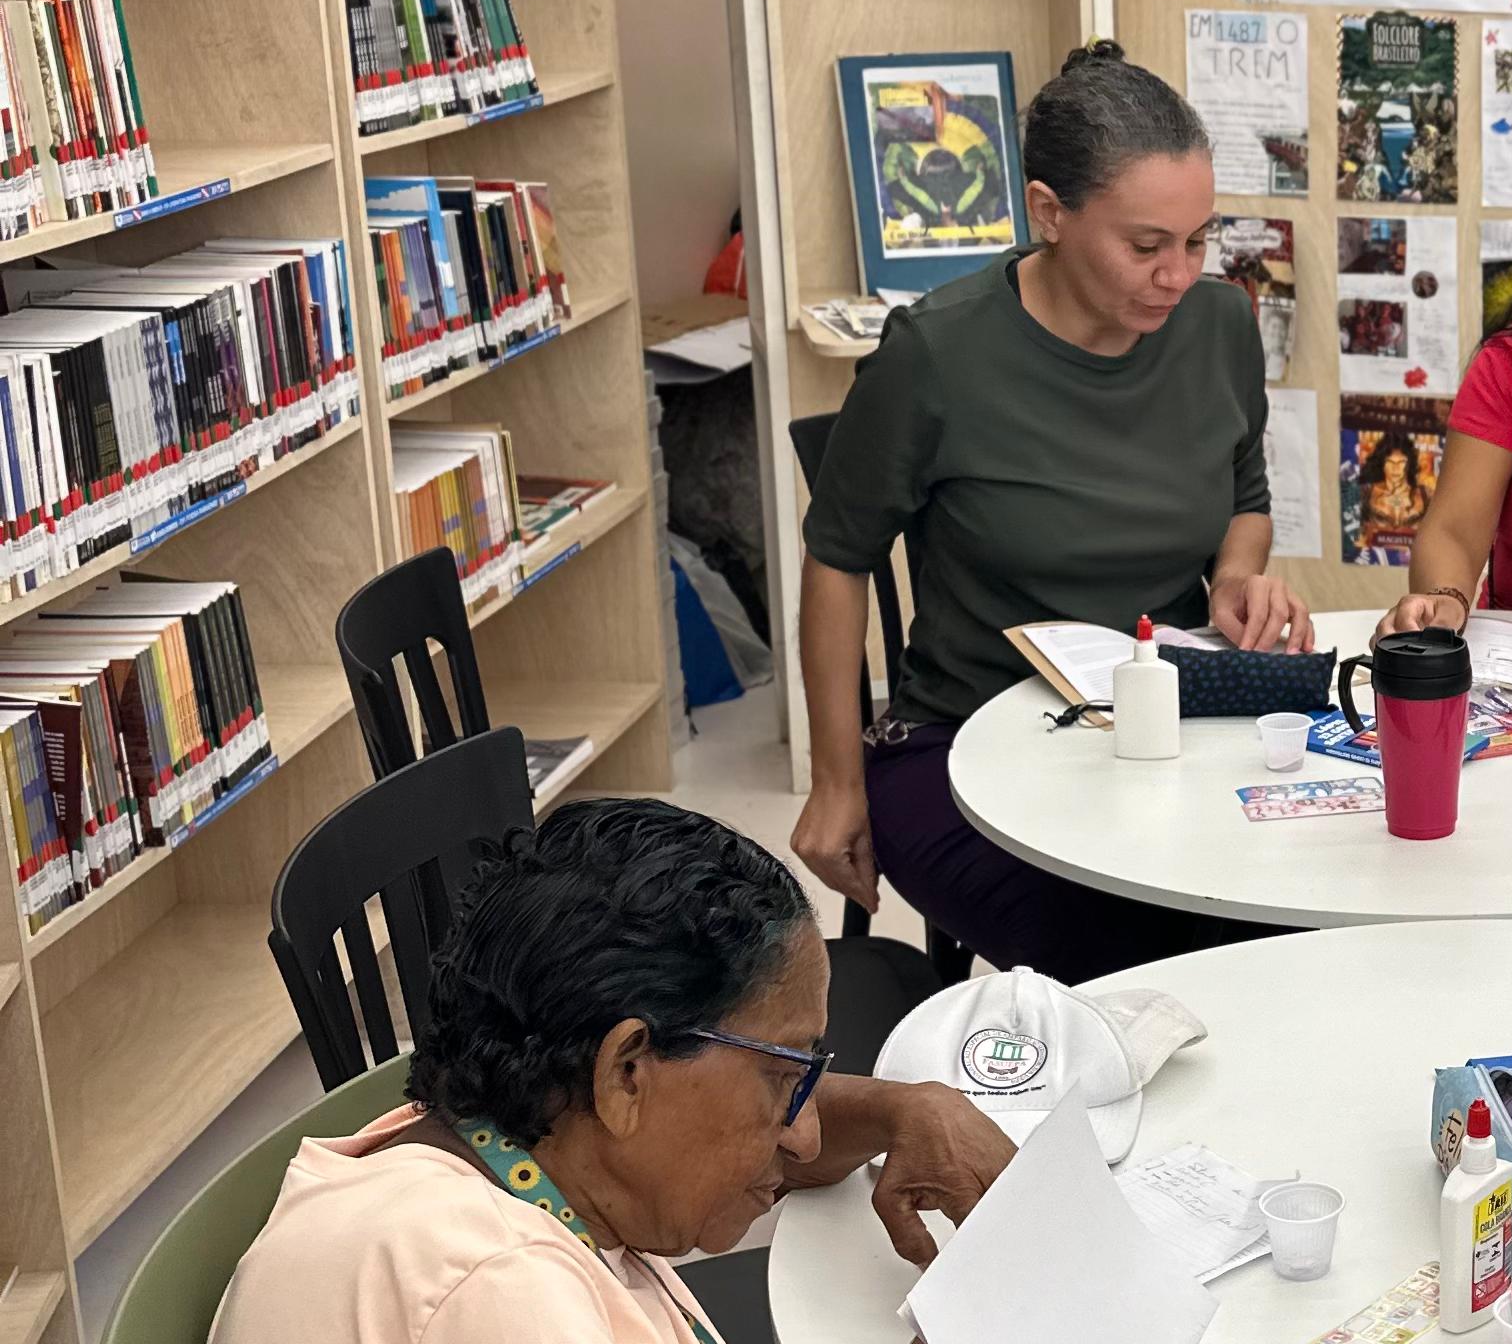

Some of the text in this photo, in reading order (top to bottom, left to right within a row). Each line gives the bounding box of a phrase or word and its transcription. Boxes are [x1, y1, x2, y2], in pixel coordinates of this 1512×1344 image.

[1372, 23, 1420, 46] FOLCLORE
[1204, 47, 1291, 81] TREM
[1373, 44, 1421, 64] BRASILEIRO
